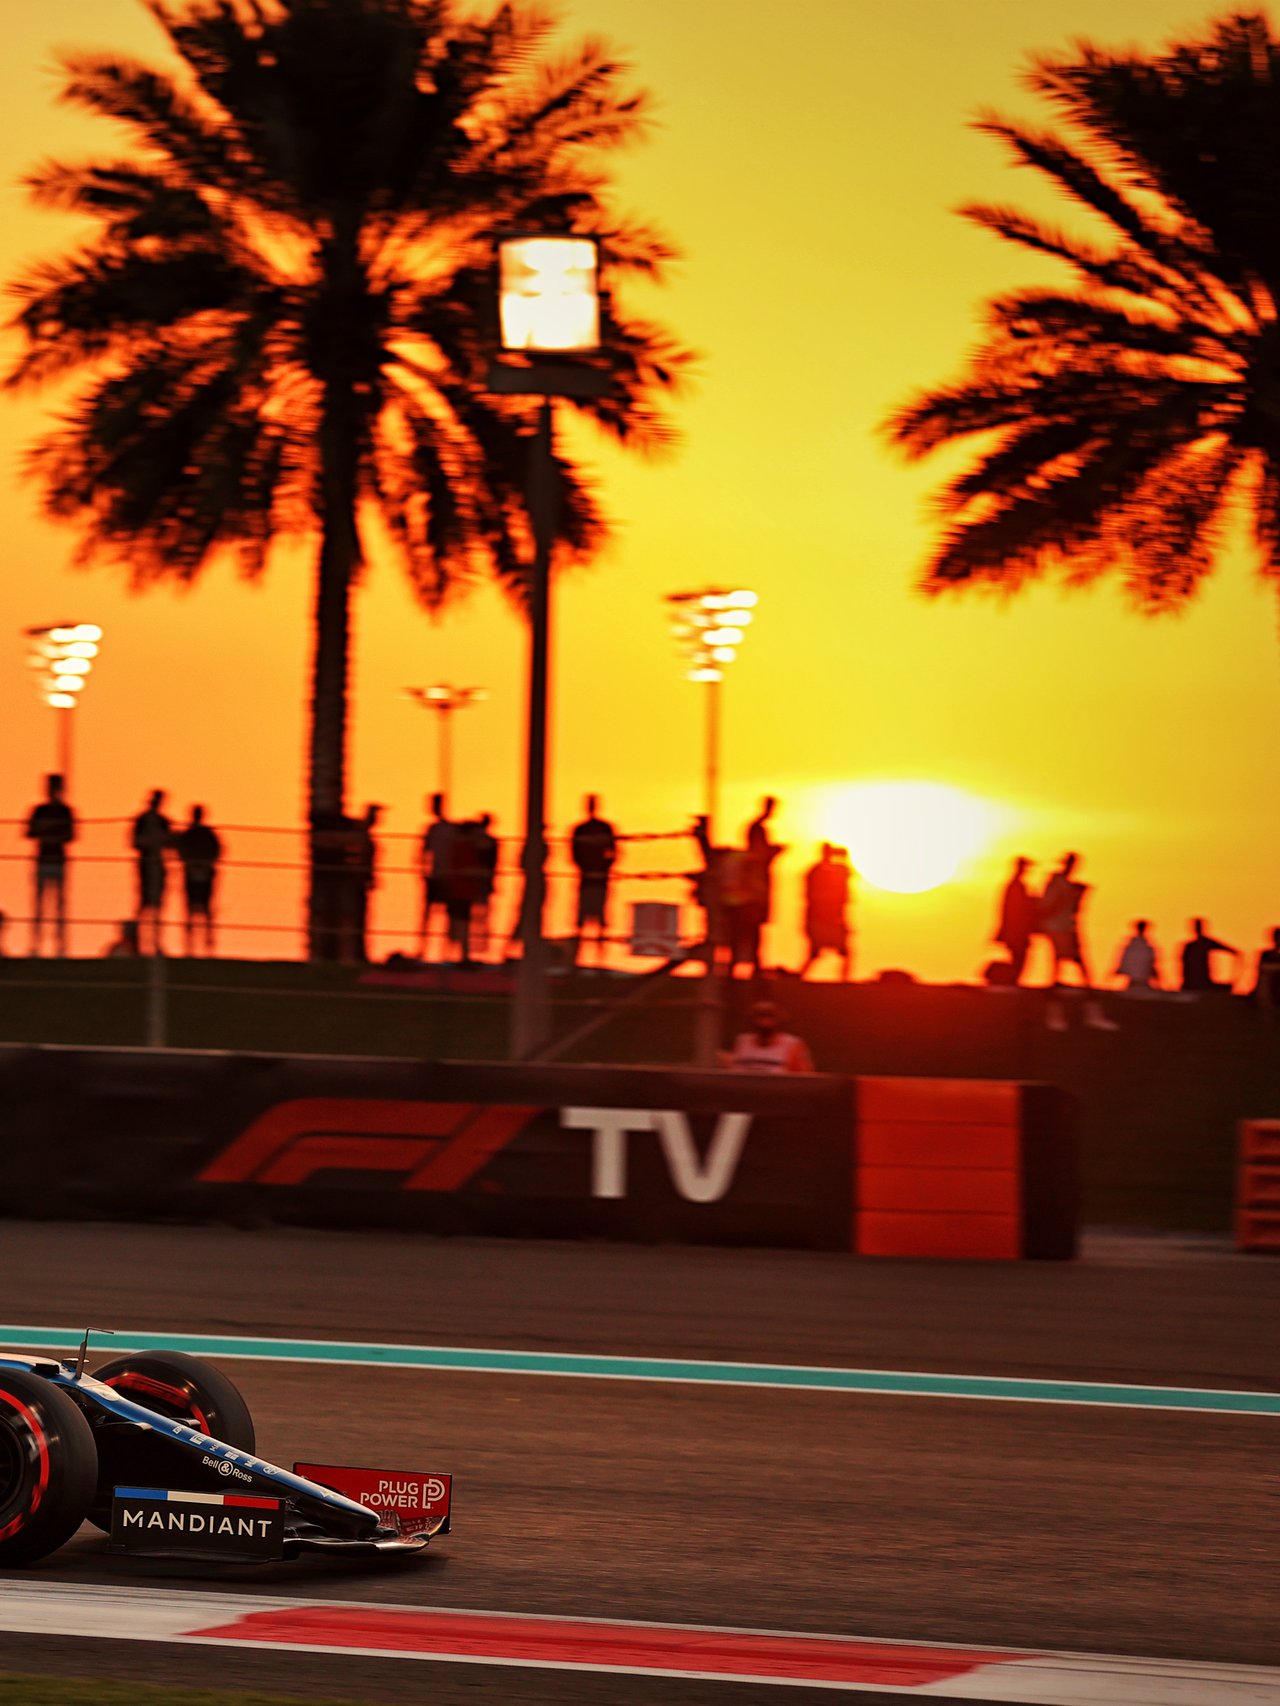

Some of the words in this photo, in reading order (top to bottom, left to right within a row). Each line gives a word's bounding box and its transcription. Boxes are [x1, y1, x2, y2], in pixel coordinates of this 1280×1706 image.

[560, 1106, 753, 1202] TV
[202, 1455, 219, 1469] Bell
[232, 1468, 253, 1483] Ross
[360, 1492, 419, 1509] POWER
[379, 1480, 419, 1495] PLUG
[122, 1509, 273, 1538] MANDIANT
